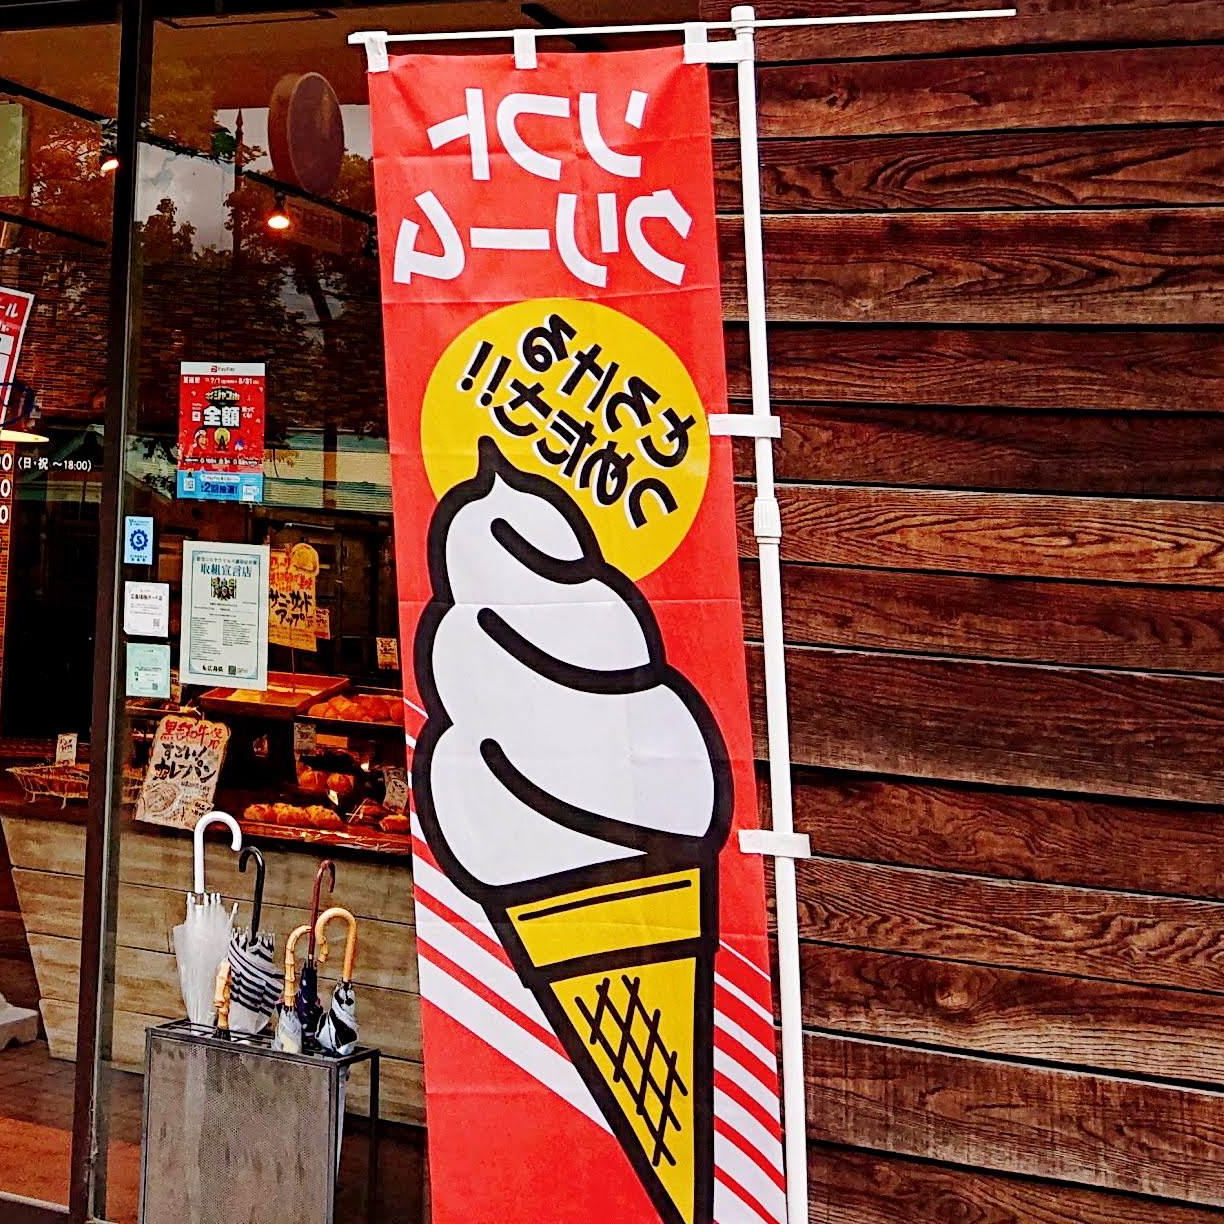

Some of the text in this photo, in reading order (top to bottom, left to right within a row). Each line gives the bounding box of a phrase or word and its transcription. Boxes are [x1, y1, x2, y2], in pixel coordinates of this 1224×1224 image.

[203, 405, 241, 427] 全額
[275, 609, 306, 627] アップ
[152, 757, 217, 783] カレーパン
